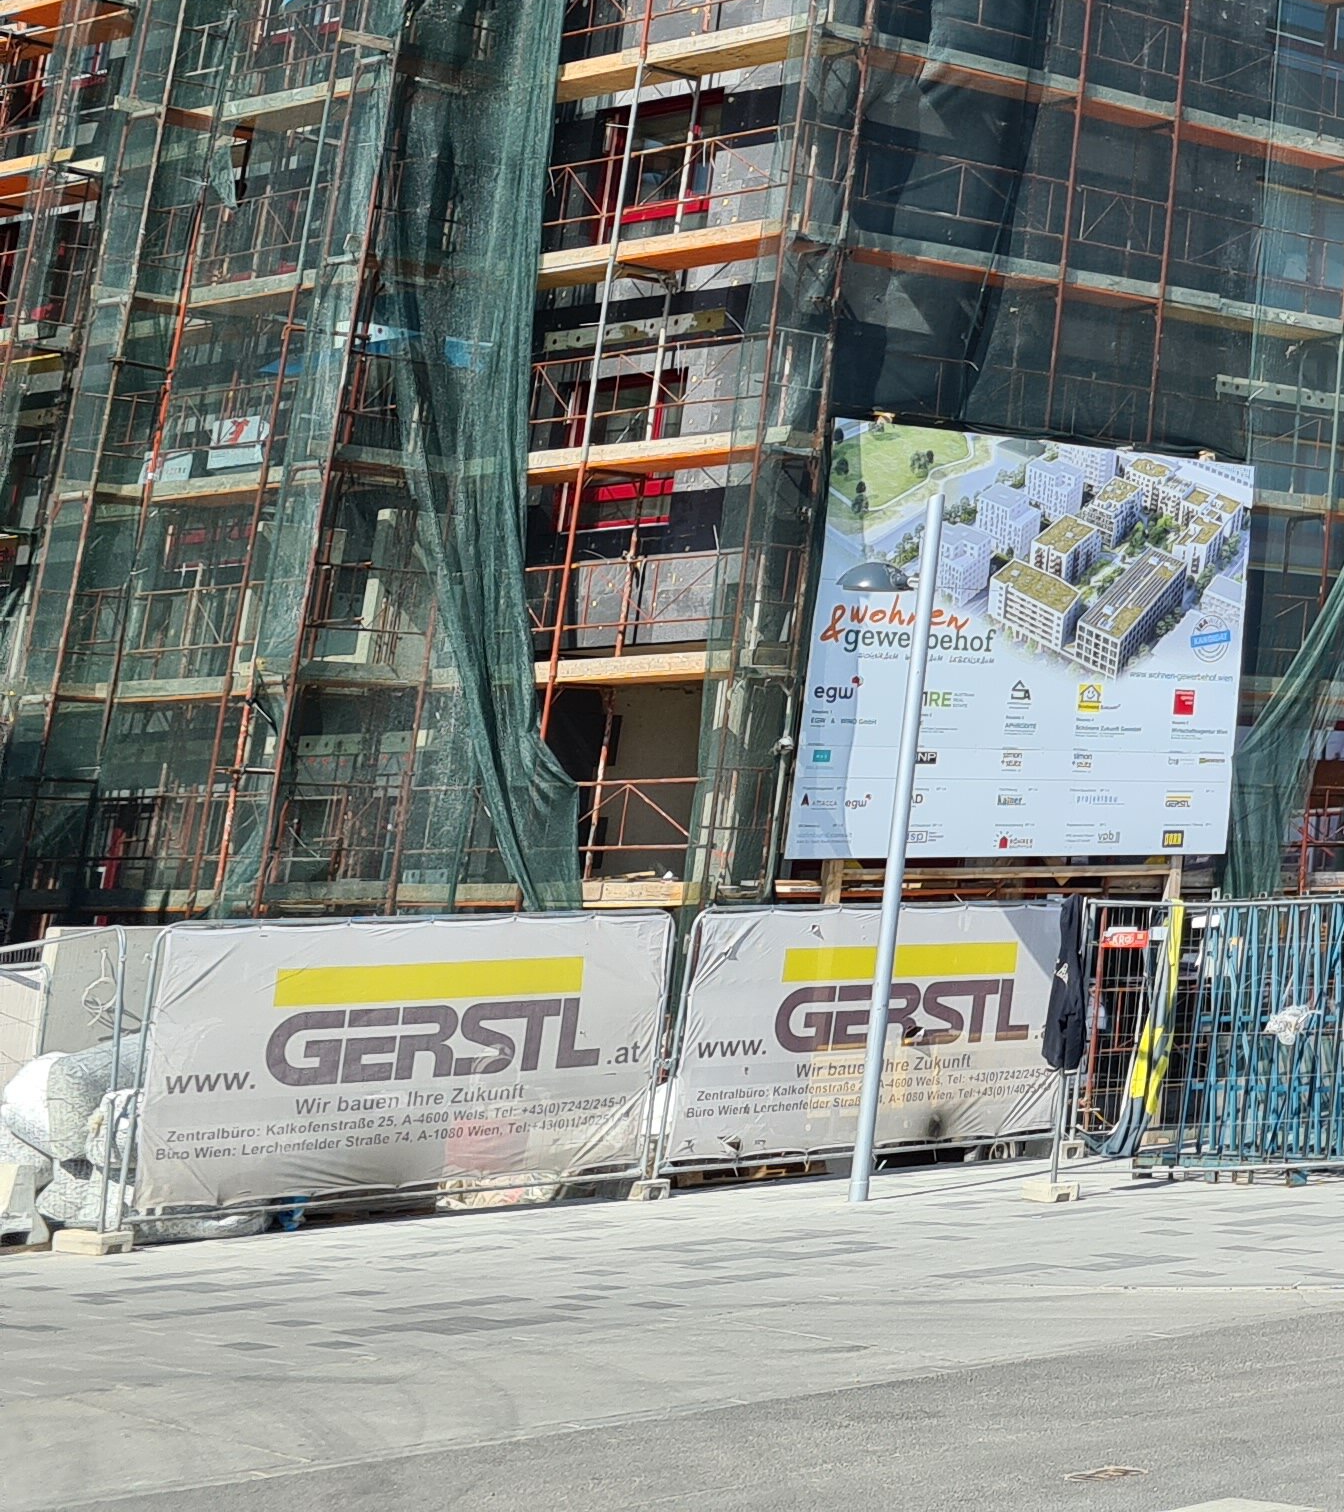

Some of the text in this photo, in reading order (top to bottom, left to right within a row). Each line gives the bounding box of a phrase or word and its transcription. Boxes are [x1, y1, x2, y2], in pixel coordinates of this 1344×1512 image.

[844, 628, 997, 653] gewebehof
[814, 686, 854, 703] egw
[165, 997, 641, 1095] www. GERSTL .at
[697, 1038, 767, 1059] www.
[796, 1062, 824, 1078] Wir
[828, 1061, 866, 1077] baue
[914, 1053, 971, 1072] Zukunft
[295, 1083, 525, 1115] Wir bauen Ihre Zukunft
[697, 1087, 770, 1102] Zentralbüro:
[773, 1081, 856, 1097] Kalkofenstraße
[916, 1074, 943, 1088] Wels,
[686, 1106, 715, 1118] Büro
[753, 1098, 831, 1114] Lerchenfelder
[832, 1095, 862, 1108] Straß
[167, 1125, 261, 1143] Zentralbüro:
[266, 1117, 375, 1136] Kalkofenstraße
[377, 1114, 398, 1129] 25,
[402, 1110, 449, 1125] A-4600
[453, 1107, 489, 1122] Wels,
[194, 1145, 236, 1159] Wien:
[241, 1137, 343, 1157] Lerchenfelder
[345, 1133, 390, 1148] Straße
[394, 1131, 414, 1144] 74,
[468, 1124, 503, 1138] Wien,
